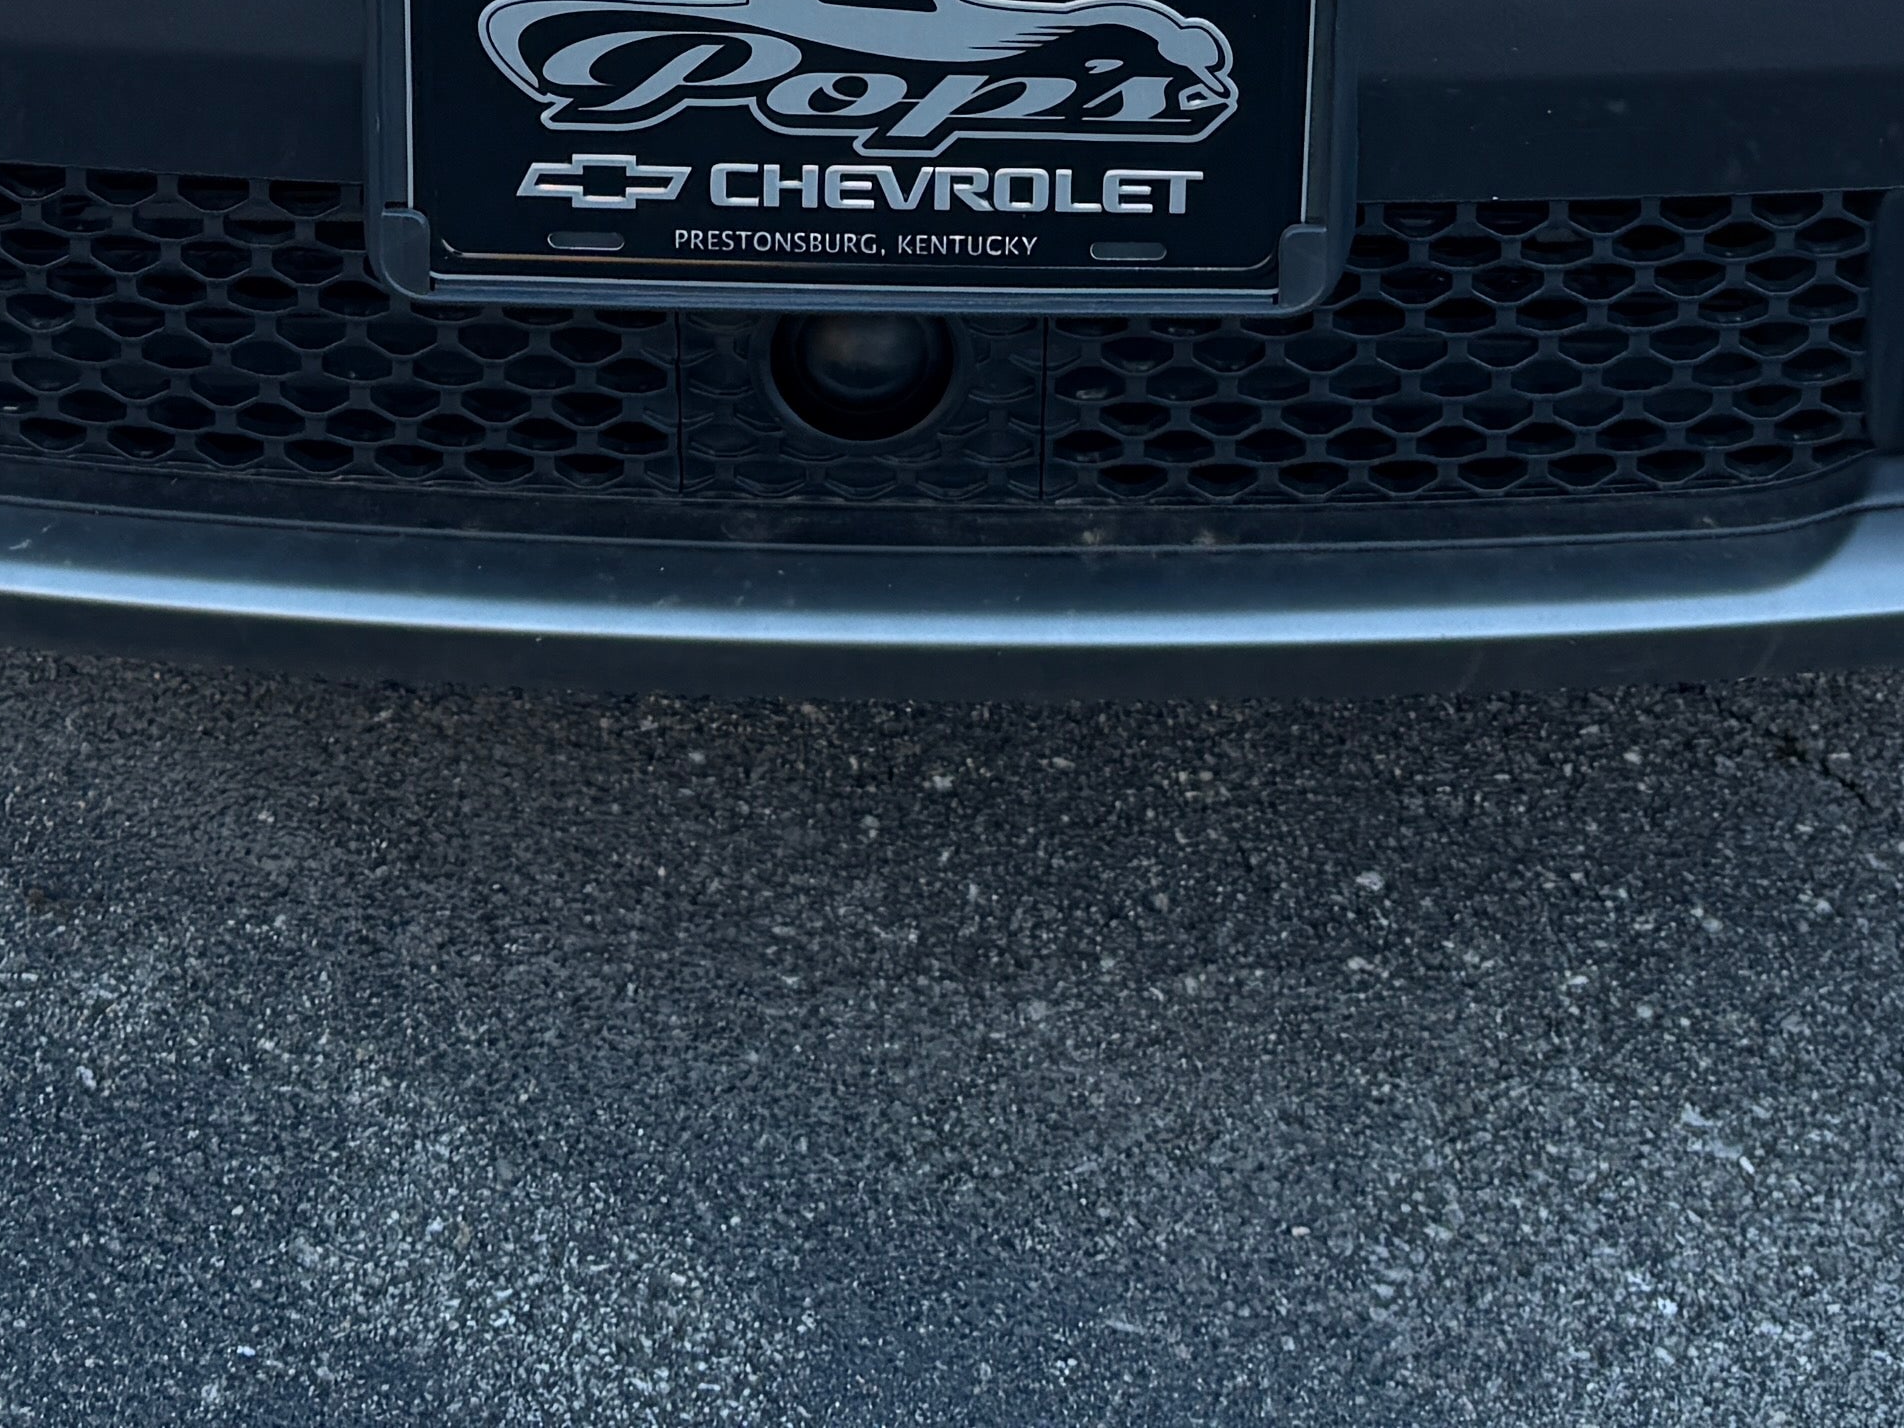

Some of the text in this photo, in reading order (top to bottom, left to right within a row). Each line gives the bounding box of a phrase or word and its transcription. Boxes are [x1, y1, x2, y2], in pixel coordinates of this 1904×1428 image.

[542, 31, 1192, 138] Pop's
[709, 162, 1204, 215] CHEVROLET
[673, 228, 1038, 259] PRESTONSBURG, KENTUCKY
